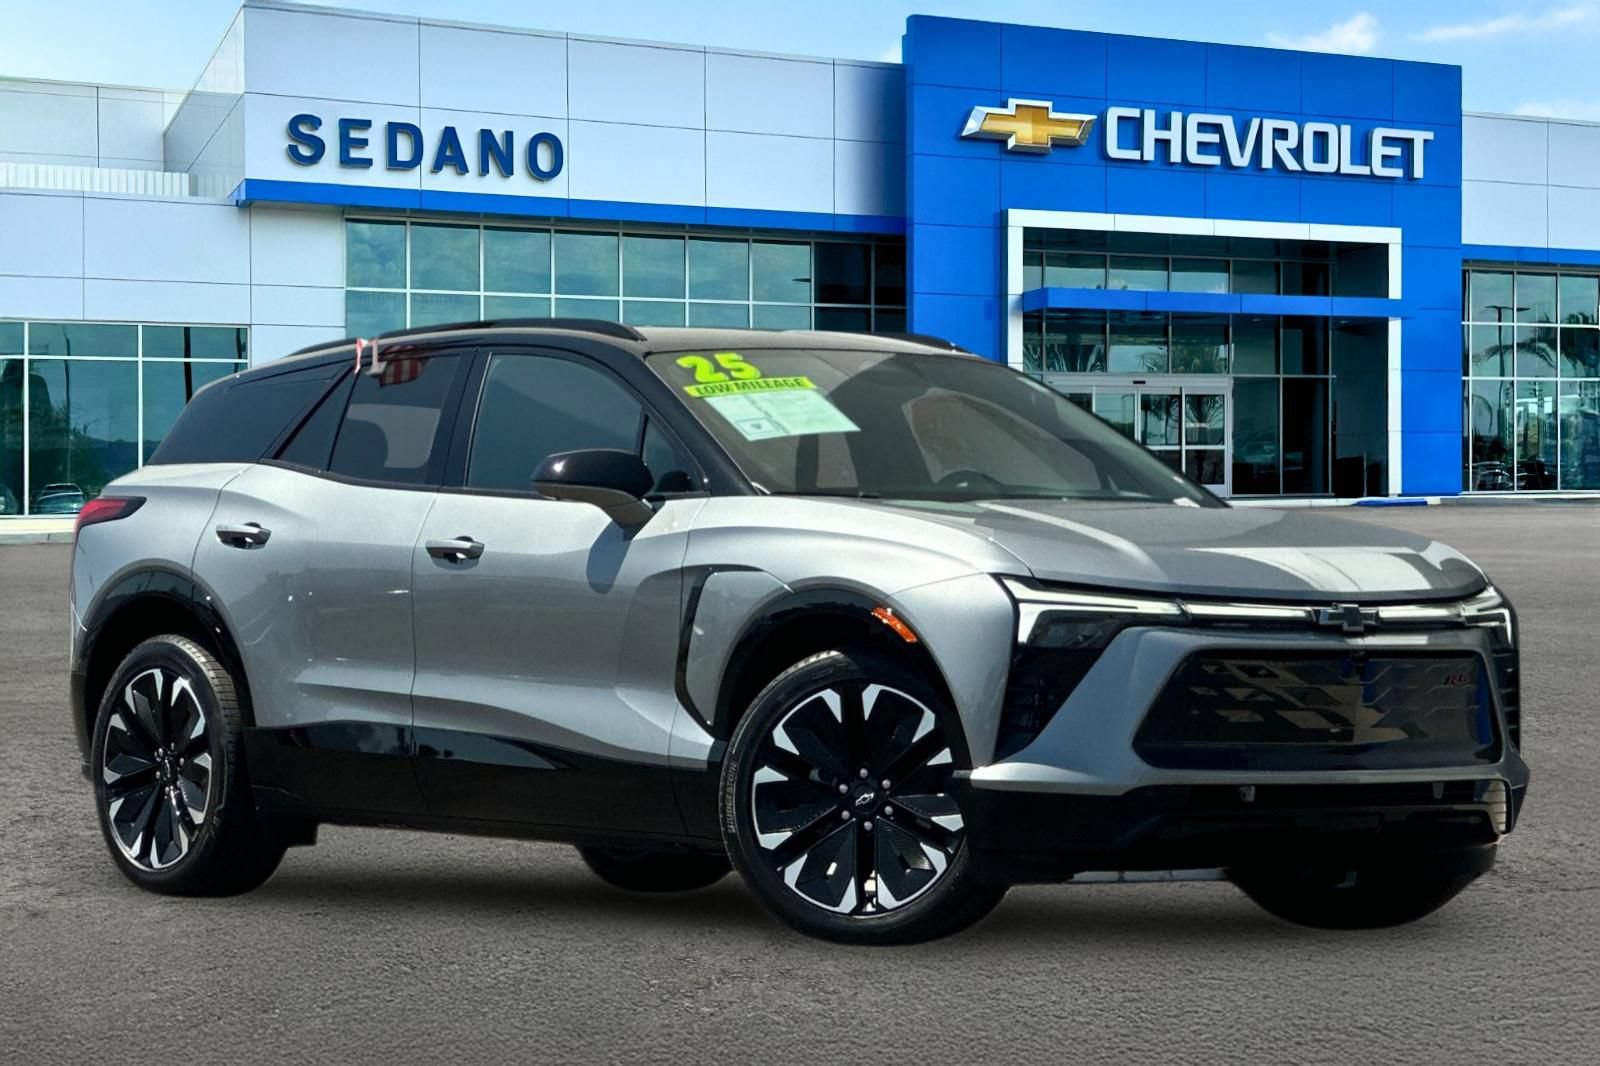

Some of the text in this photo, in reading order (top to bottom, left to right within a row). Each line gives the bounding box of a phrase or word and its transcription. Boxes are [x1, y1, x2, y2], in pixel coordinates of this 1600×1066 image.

[287, 113, 564, 181] SEDANO
[1105, 106, 1435, 179] CHEVROLET
[676, 352, 761, 382] 25
[695, 378, 803, 395] LOW MILEAGE
